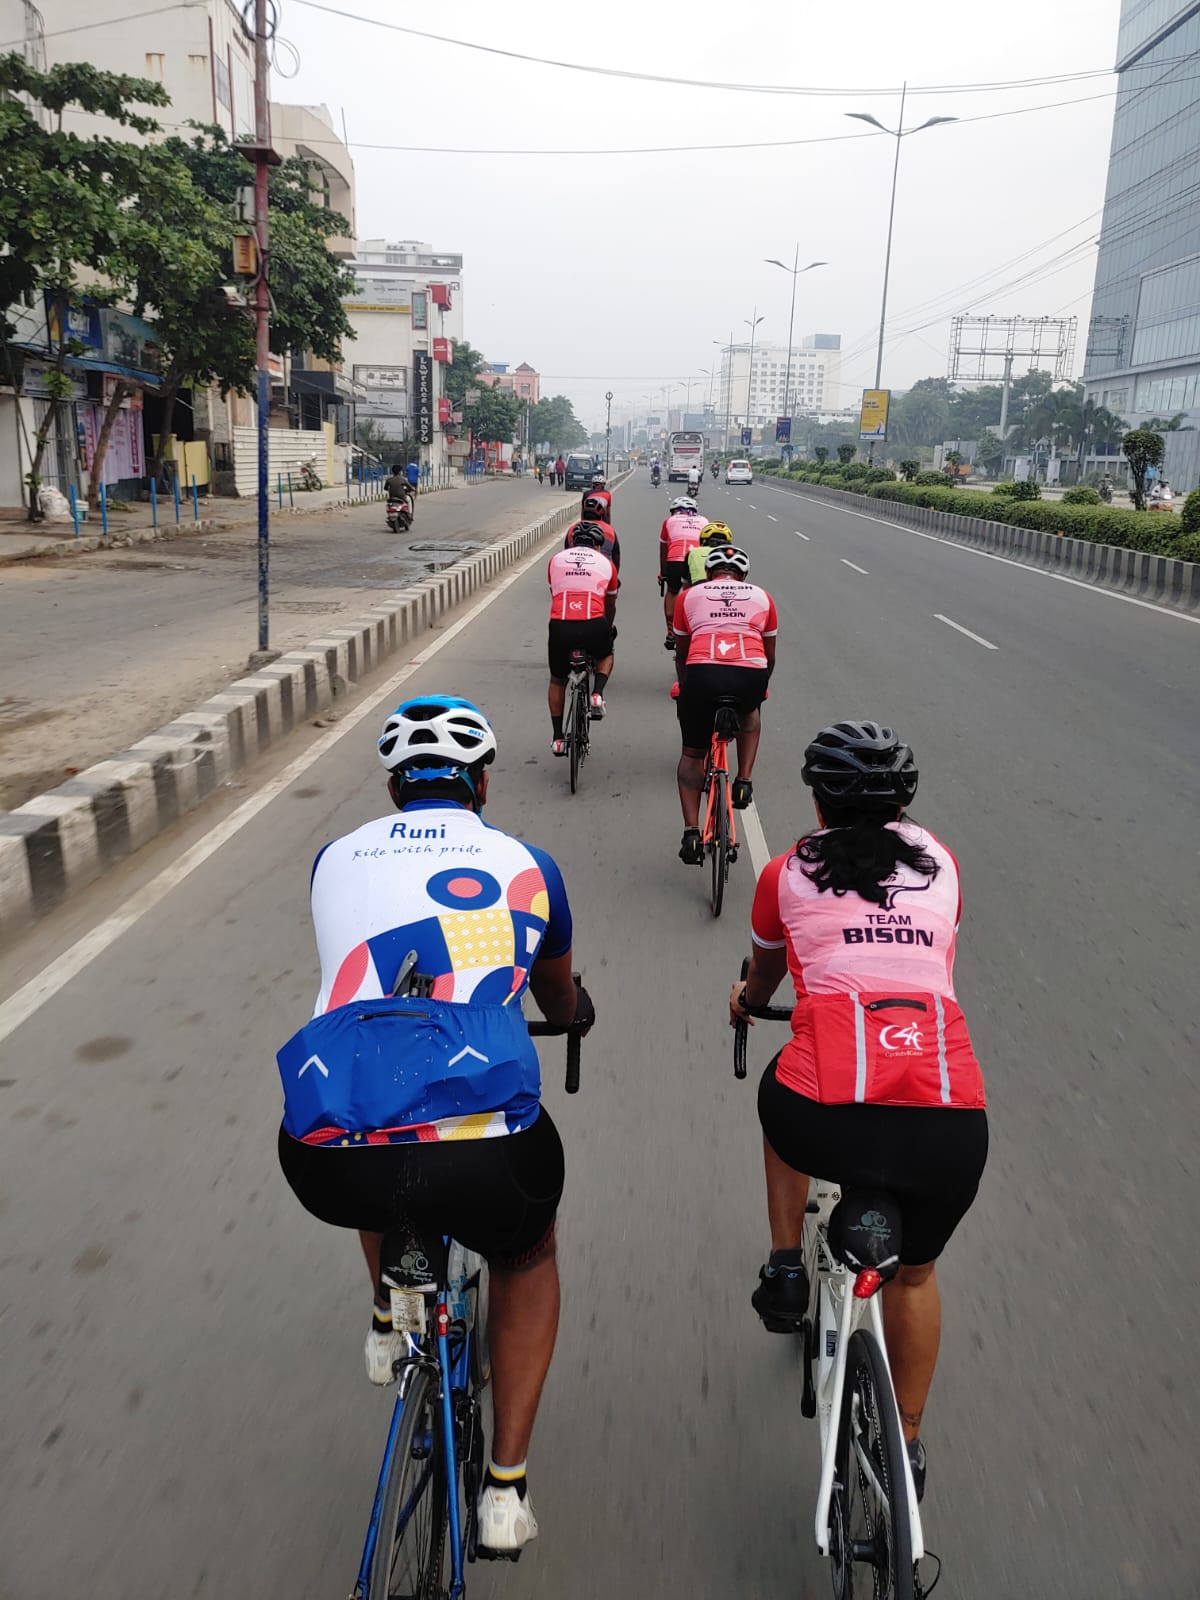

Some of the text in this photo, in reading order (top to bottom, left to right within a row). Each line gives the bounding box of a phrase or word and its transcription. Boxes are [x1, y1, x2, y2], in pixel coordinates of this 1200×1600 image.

[389, 822, 446, 839] Runi
[393, 843, 434, 855] with
[438, 843, 484, 857] pride
[865, 914, 912, 926] TEAM
[842, 927, 934, 948] BISON
